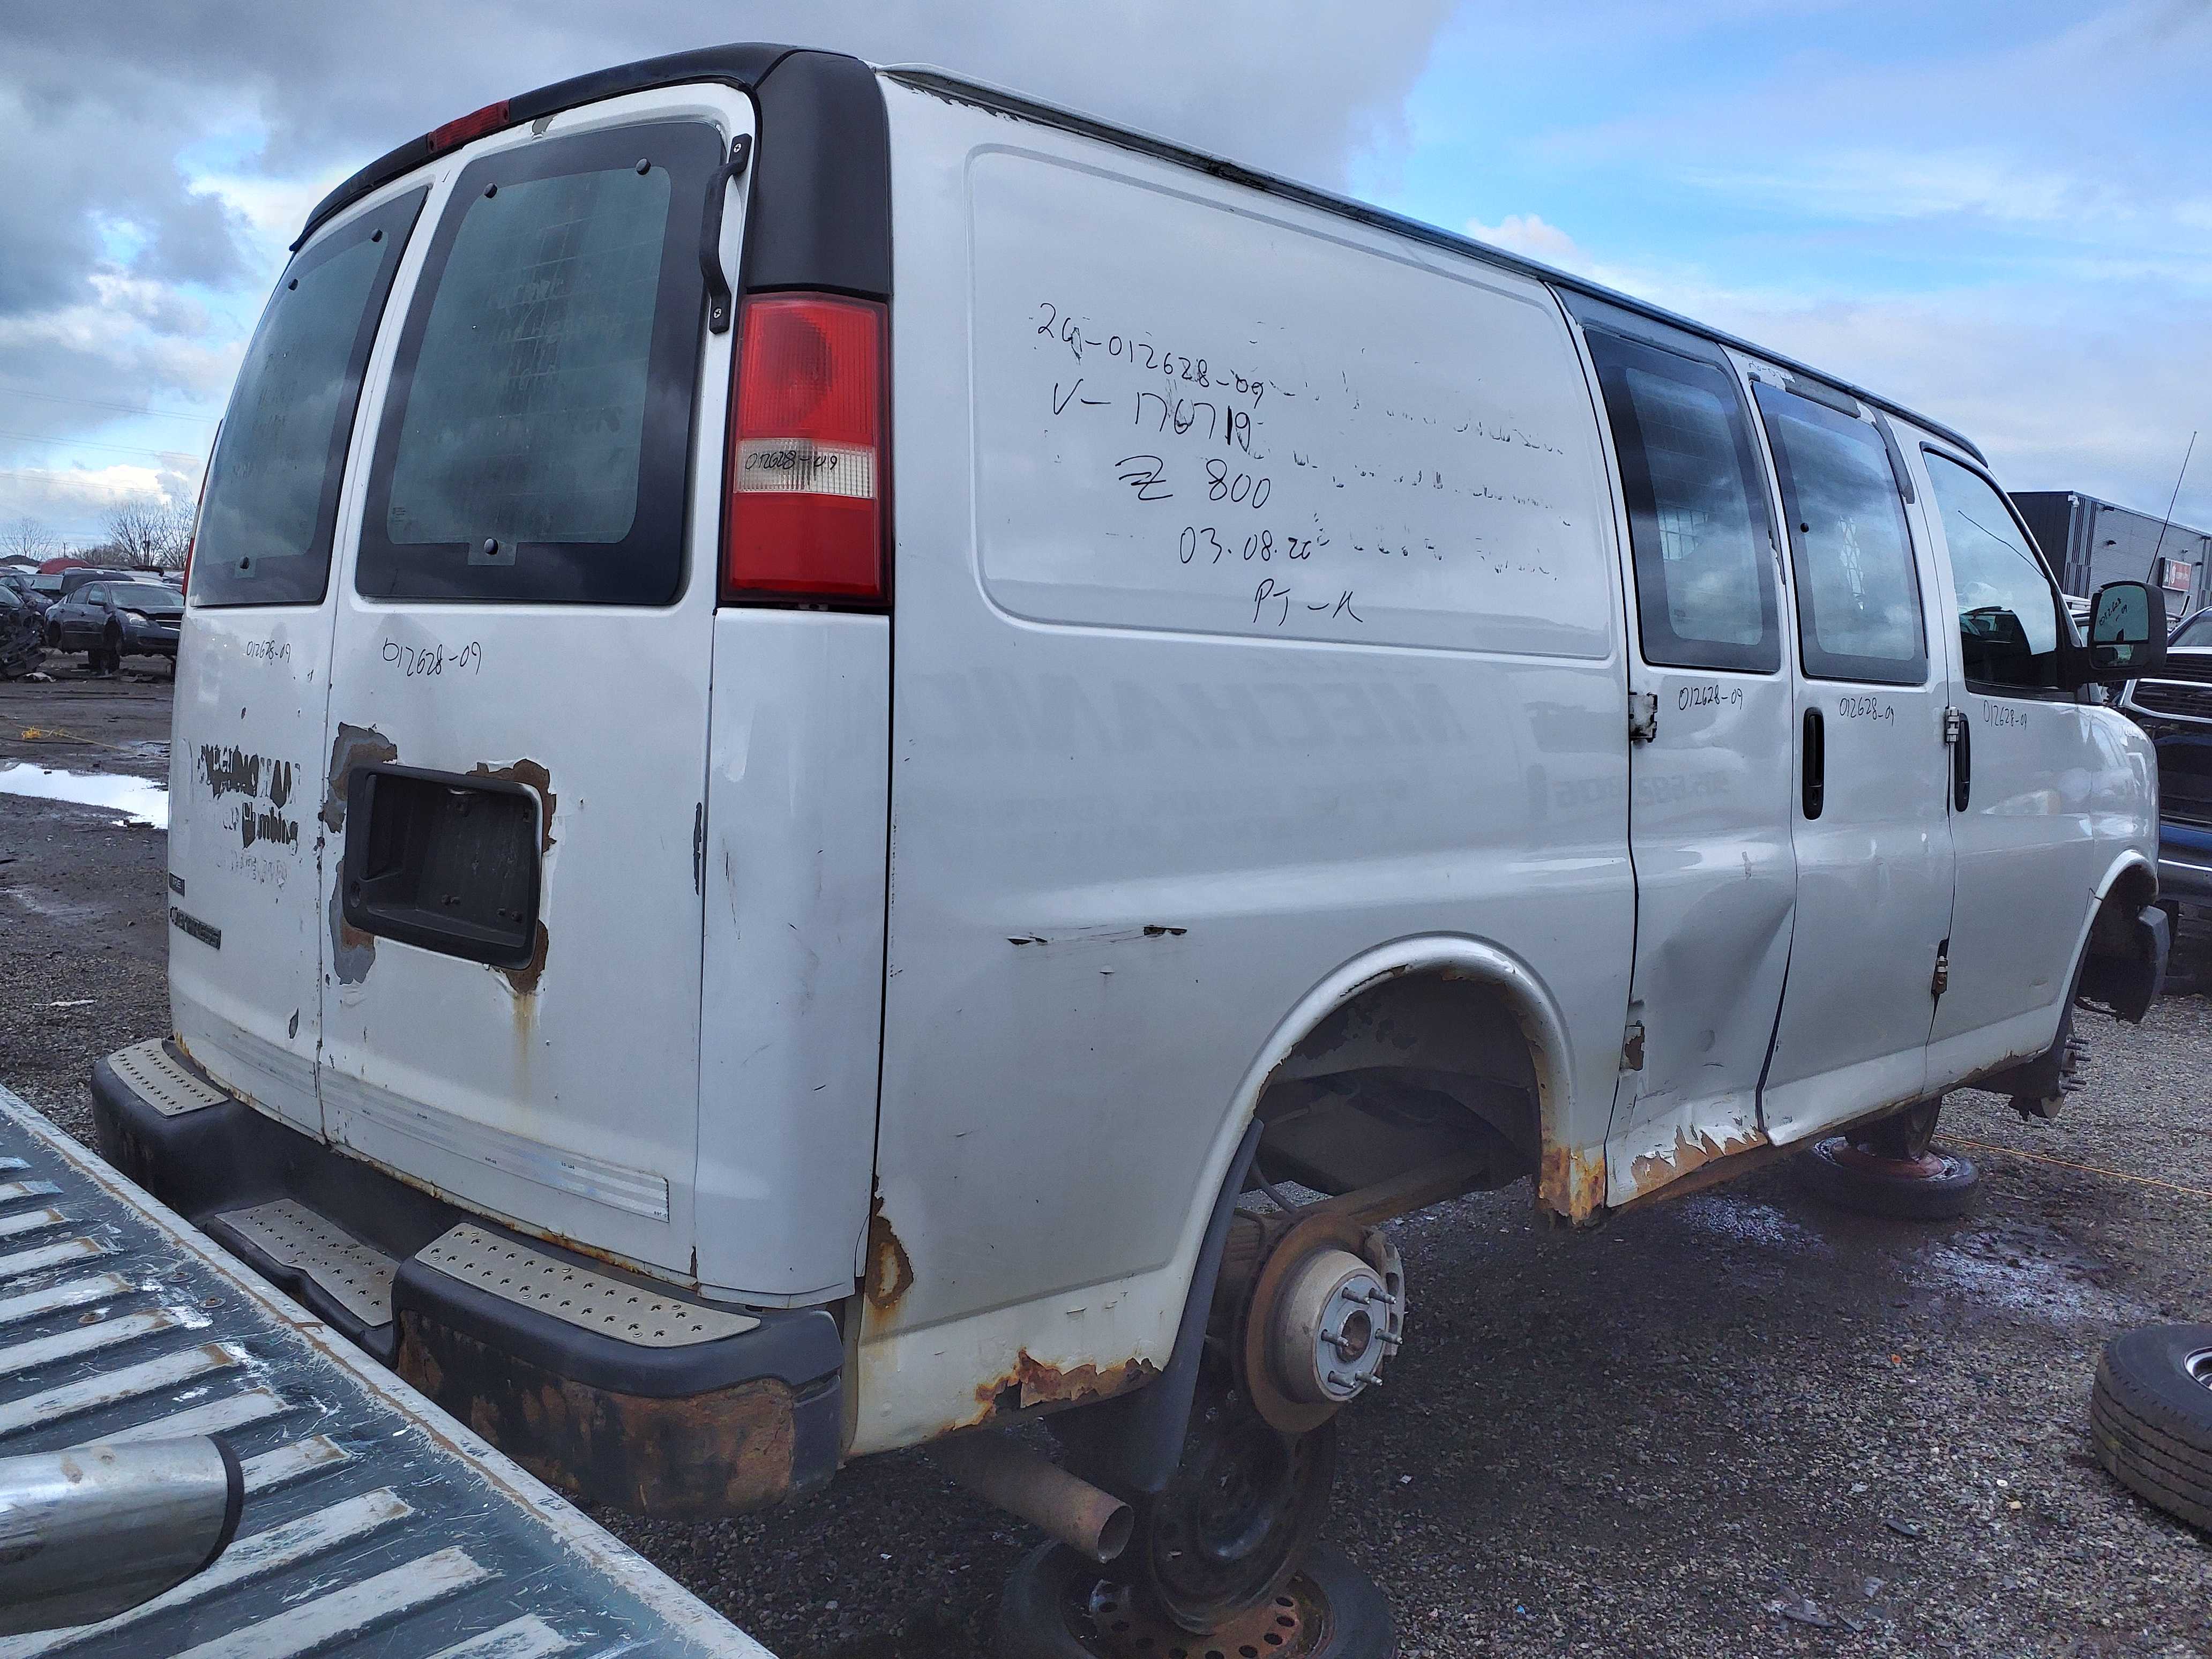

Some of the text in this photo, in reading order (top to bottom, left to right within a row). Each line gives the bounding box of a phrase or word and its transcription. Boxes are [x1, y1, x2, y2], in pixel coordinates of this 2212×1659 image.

[1206, 459, 1271, 509] 800
[383, 637, 482, 676] 012628-09
[1678, 684, 1743, 711] 012628-09
[1839, 697, 1894, 727] 012628-09
[1983, 699, 2028, 730] 012628-09
